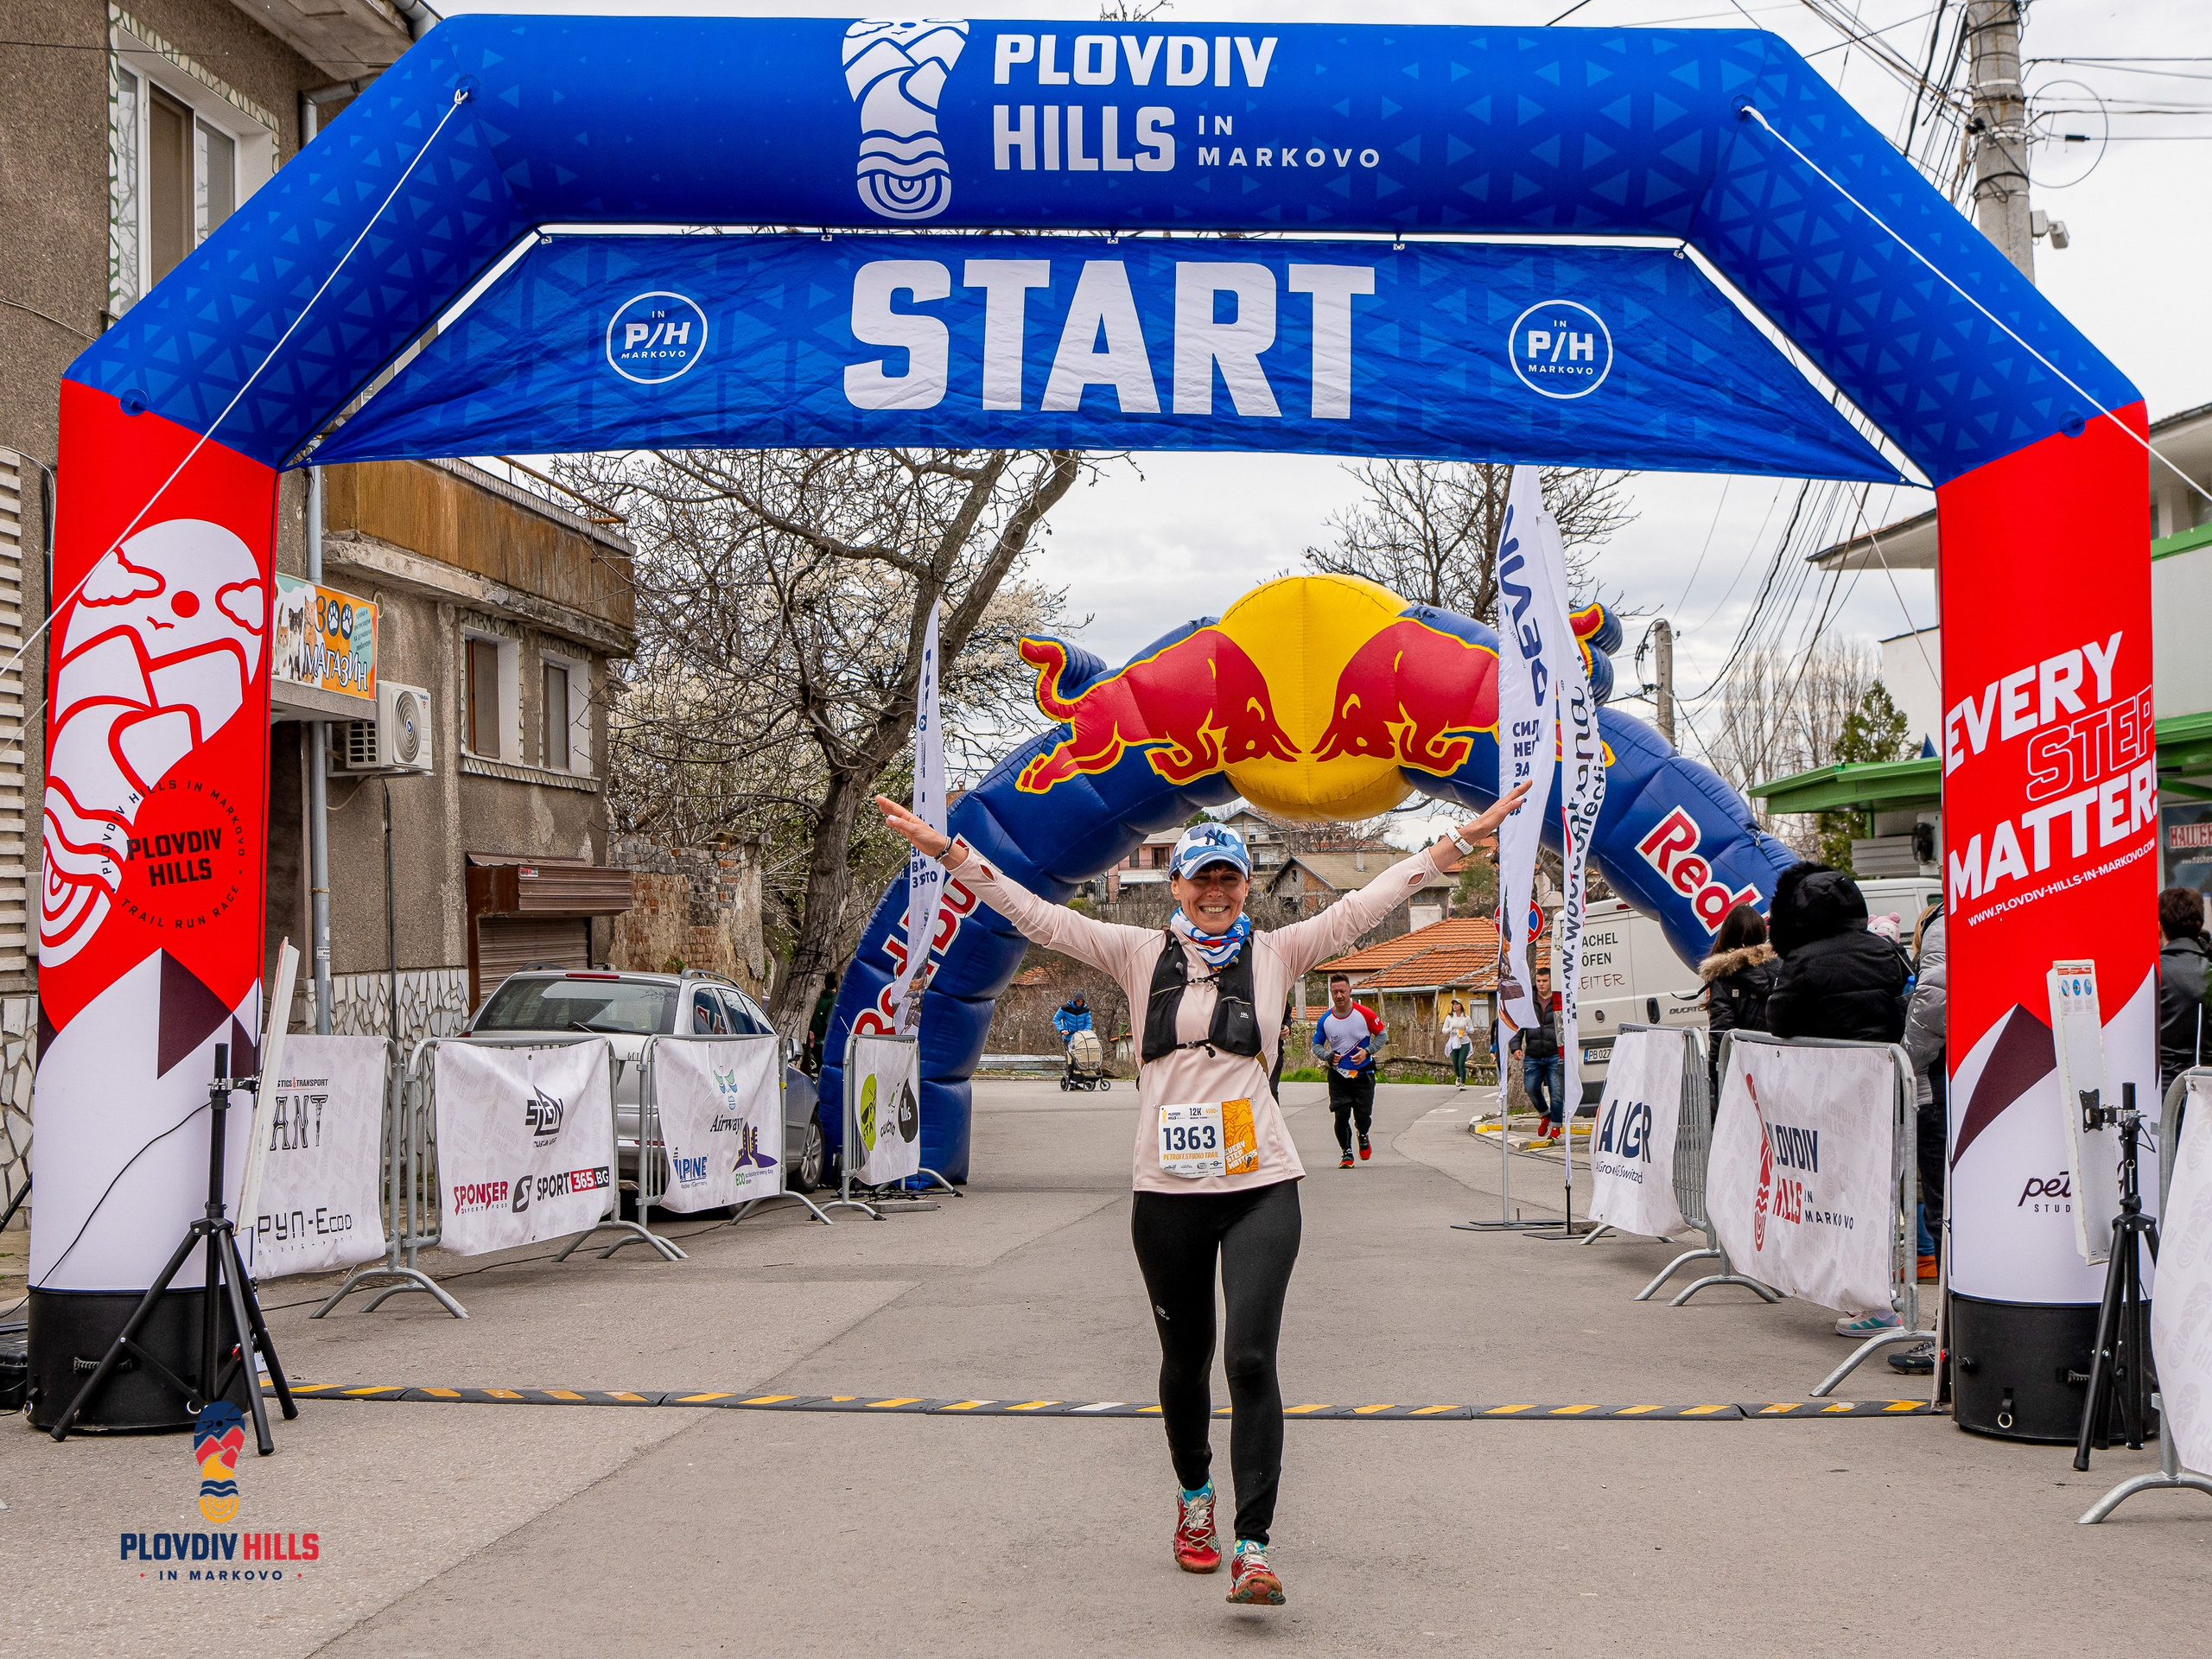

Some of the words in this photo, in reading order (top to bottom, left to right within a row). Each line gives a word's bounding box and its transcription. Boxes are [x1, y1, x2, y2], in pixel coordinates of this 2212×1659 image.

[994, 33, 1279, 87] PLOVDIV
[994, 104, 1176, 173] HILLS
[1198, 115, 1233, 136] IN
[1198, 147, 1380, 168] MARKOVO
[652, 310, 665, 319] IN
[625, 321, 691, 350] P/H
[843, 258, 1376, 420] START
[1528, 330, 1594, 363] P/H
[620, 350, 687, 359] MARKOVO
[1528, 364, 1594, 376] MARKOVO
[304, 642, 368, 692] МАГАЗИН
[1944, 630, 2124, 779] EVERY
[2026, 683, 2153, 803] STEP
[101, 805, 126, 875] PLOVDIV
[129, 779, 177, 804] HILLS
[187, 780, 203, 792] IN
[210, 789, 245, 856] MARKOVO
[126, 827, 222, 861] PLOVDIV
[148, 857, 213, 887] HILLS
[1637, 808, 1760, 933] Red
[1967, 836, 2156, 928] WWW.PLOVDIV-HILLS-IN-MARKOVO.COM
[121, 898, 165, 928] TRAIL
[175, 915, 207, 929] RUN
[211, 884, 239, 918] RACE
[1581, 931, 1618, 948] ACHEL
[1581, 951, 1612, 967] ÖFEN
[1588, 1049, 1598, 1060] PB
[1189, 1107, 1202, 1116] 12K
[1162, 1125, 1217, 1151] 1363
[453, 1180, 509, 1217] SPONSER
[1804, 1189, 1814, 1204] IN
[2034, 1204, 2071, 1213] STUD
[1804, 1209, 1854, 1230] MARKOVO
